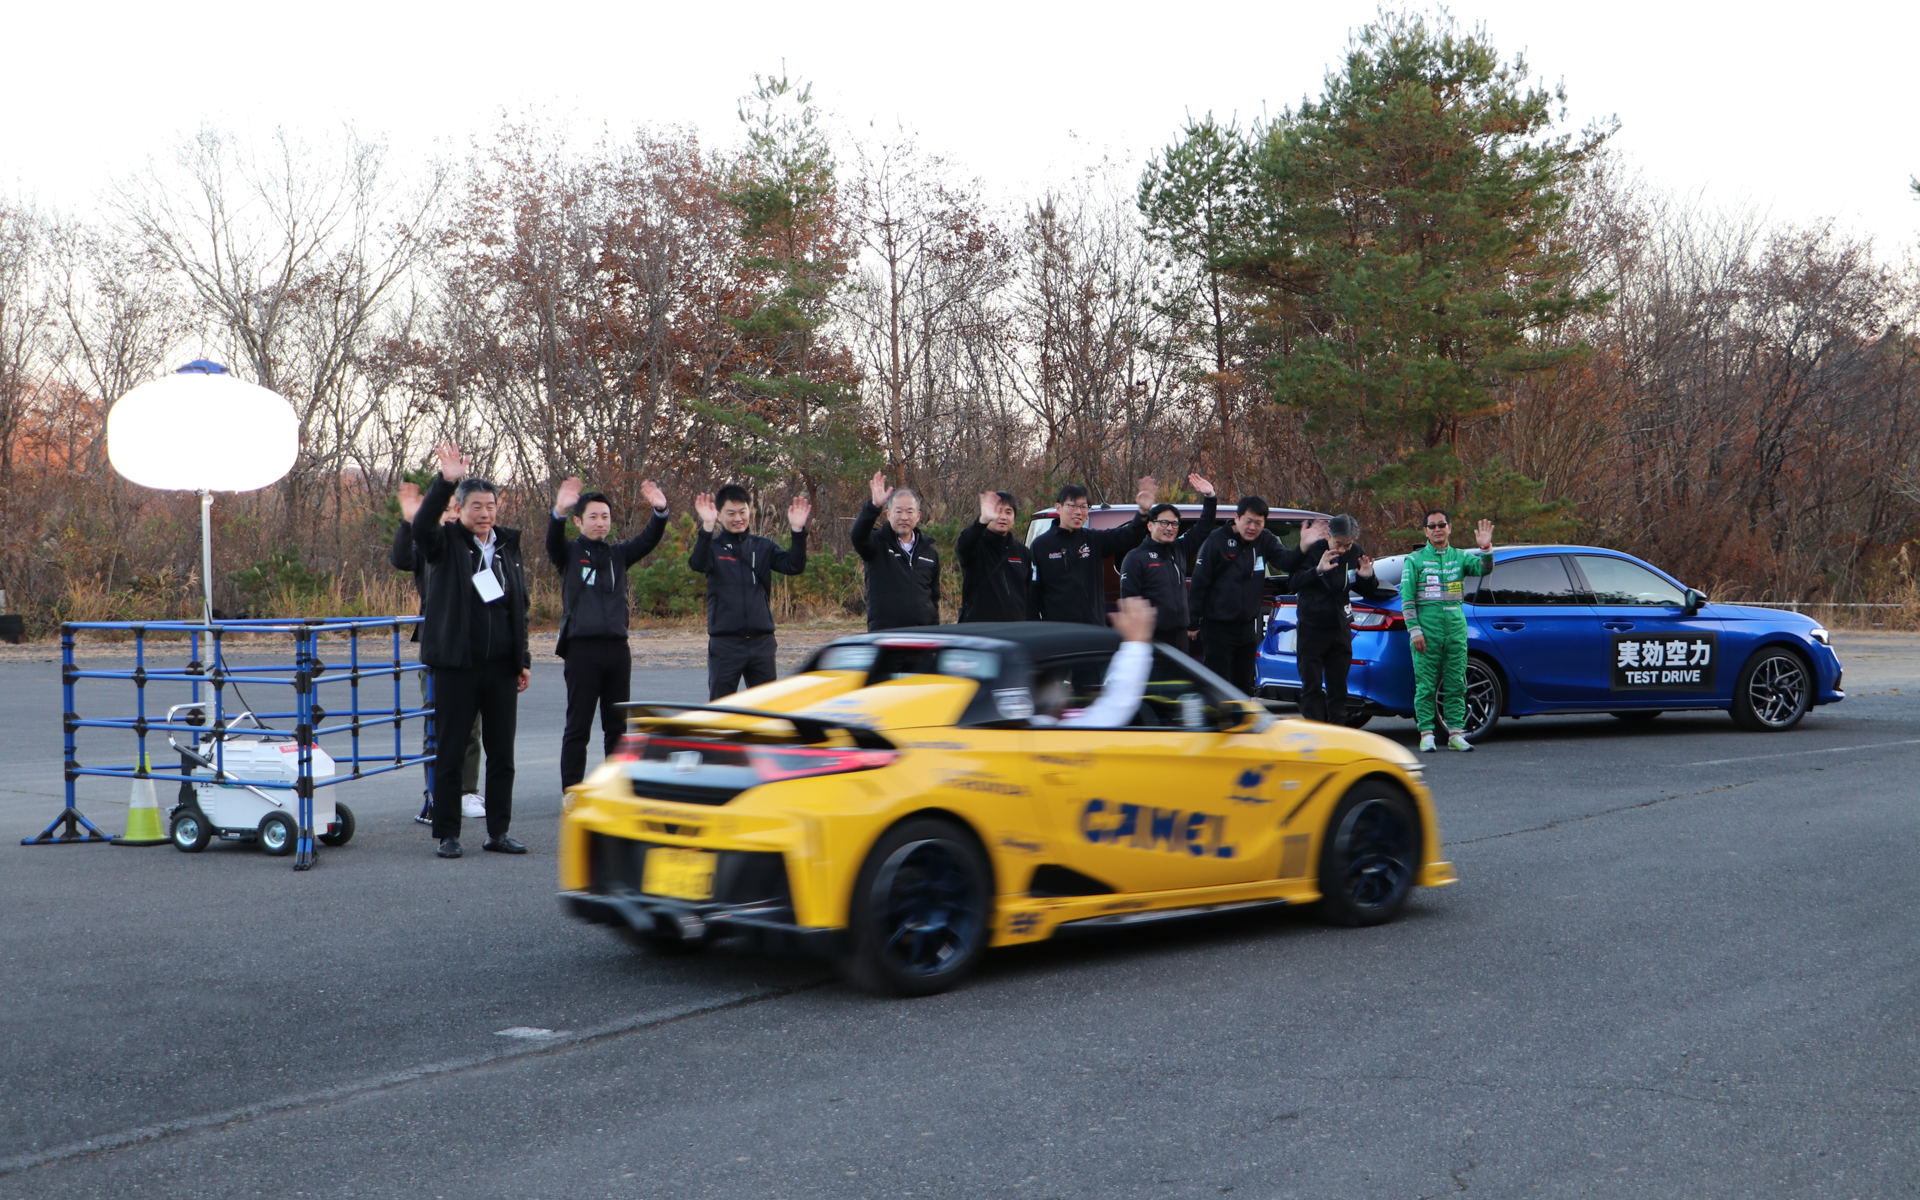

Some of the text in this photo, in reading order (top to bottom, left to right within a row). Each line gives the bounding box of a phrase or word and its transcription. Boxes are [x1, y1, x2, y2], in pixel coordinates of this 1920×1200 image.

[1617, 639, 1711, 668] 実効空力
[1625, 669, 1701, 684] TEST DRIVE
